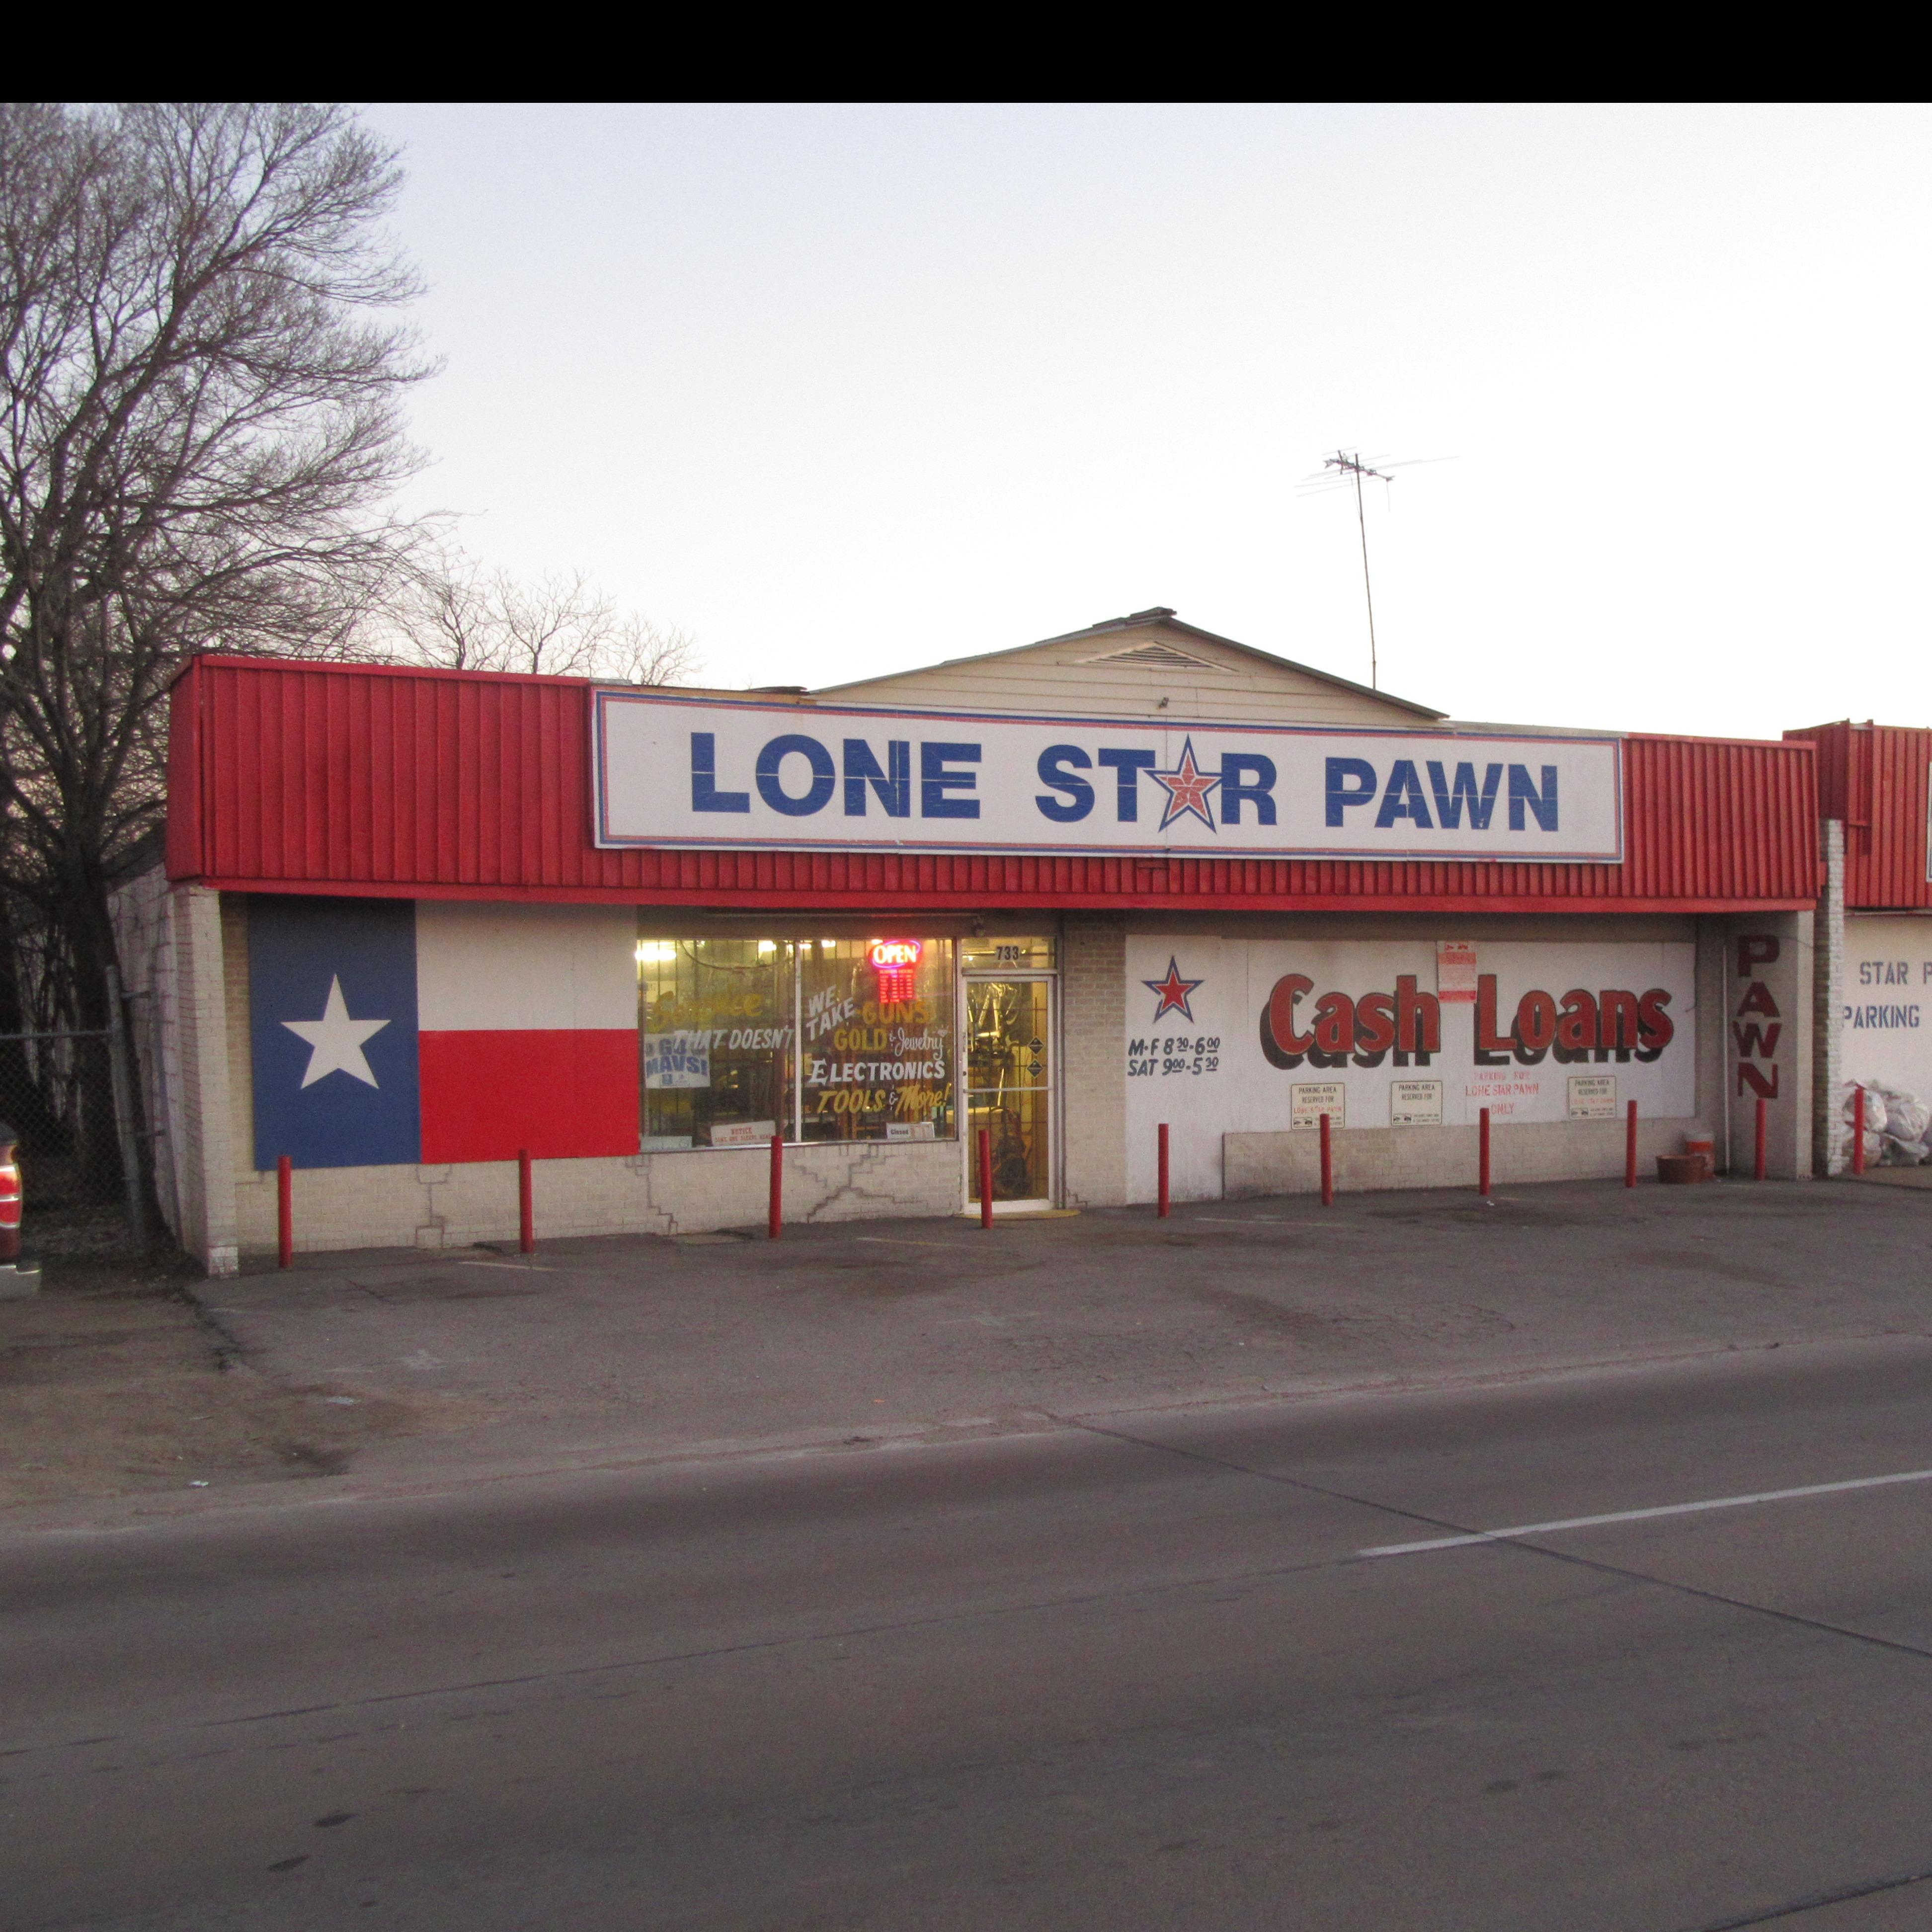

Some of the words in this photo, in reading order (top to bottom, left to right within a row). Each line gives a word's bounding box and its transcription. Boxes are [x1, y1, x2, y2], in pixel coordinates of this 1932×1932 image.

[691, 732, 982, 819] LONE
[1325, 757, 1558, 832] PAWN
[873, 945, 916, 964] OPEN
[996, 946, 1019, 960] 733
[1860, 962, 1908, 985] STAR
[809, 984, 837, 1018] WE
[863, 1001, 929, 1025] GUNS
[806, 997, 856, 1041] TAKE
[1260, 973, 1441, 1069] Cash
[1474, 974, 1674, 1066] Loans
[1732, 935, 1782, 1099] PAWN
[1842, 1005, 1920, 1029] PARKING
[674, 1030, 728, 1049] THAT
[729, 1025, 795, 1050] DOESN'T
[834, 1028, 887, 1050] GOLD
[895, 1028, 944, 1060] Jewelry
[808, 1058, 945, 1085] ELECTRONICS
[1127, 1059, 1159, 1076] SAT
[817, 1089, 886, 1113] TOOLS
[1465, 1085, 1491, 1097] LONE
[1492, 1084, 1512, 1096] STAR
[1514, 1083, 1539, 1094] PAWN
[1491, 1103, 1515, 1115] ONLY
